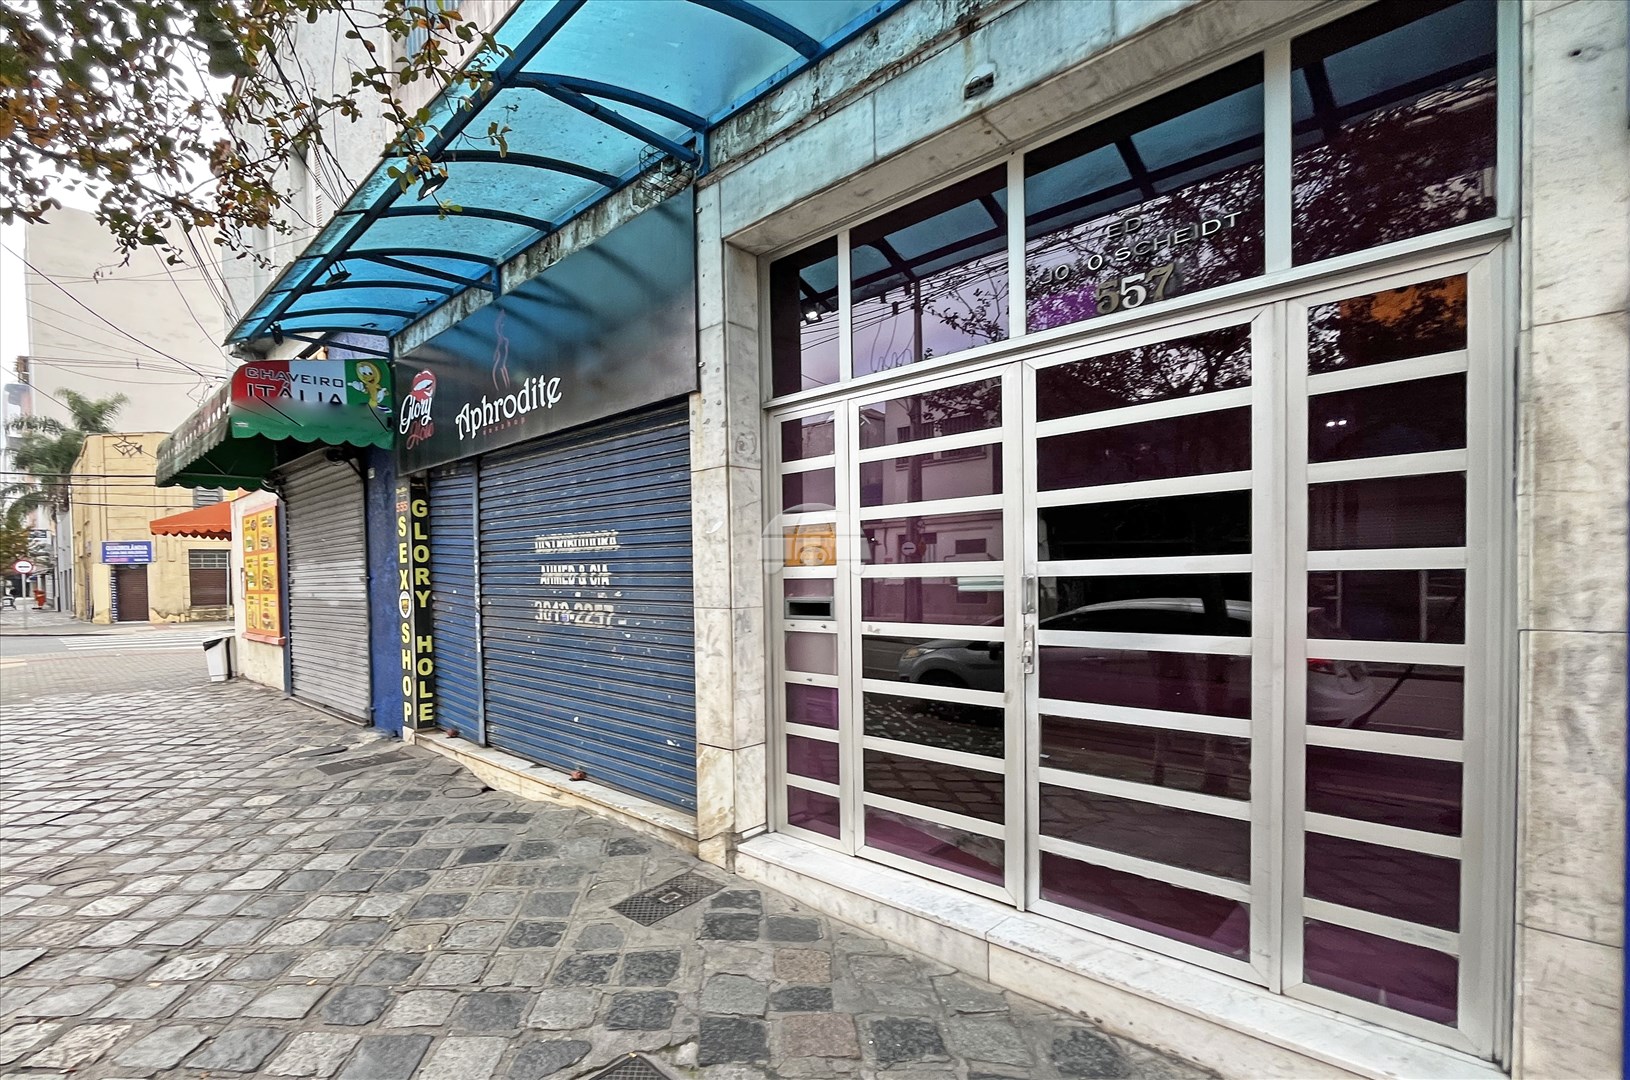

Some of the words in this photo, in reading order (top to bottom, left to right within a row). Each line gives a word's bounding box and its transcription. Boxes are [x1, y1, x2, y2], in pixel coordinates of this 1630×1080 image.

[1115, 211, 1242, 262] SCHEIDT
[1096, 262, 1175, 315] 557
[244, 366, 344, 388] CHAVEIRO
[399, 394, 432, 434] Glory
[455, 374, 562, 440] Aphrodite
[398, 516, 409, 590] SEX
[411, 499, 432, 608] GLORY
[589, 564, 611, 586] CIA
[401, 622, 412, 722] SHOP
[416, 635, 434, 721] HOLE
